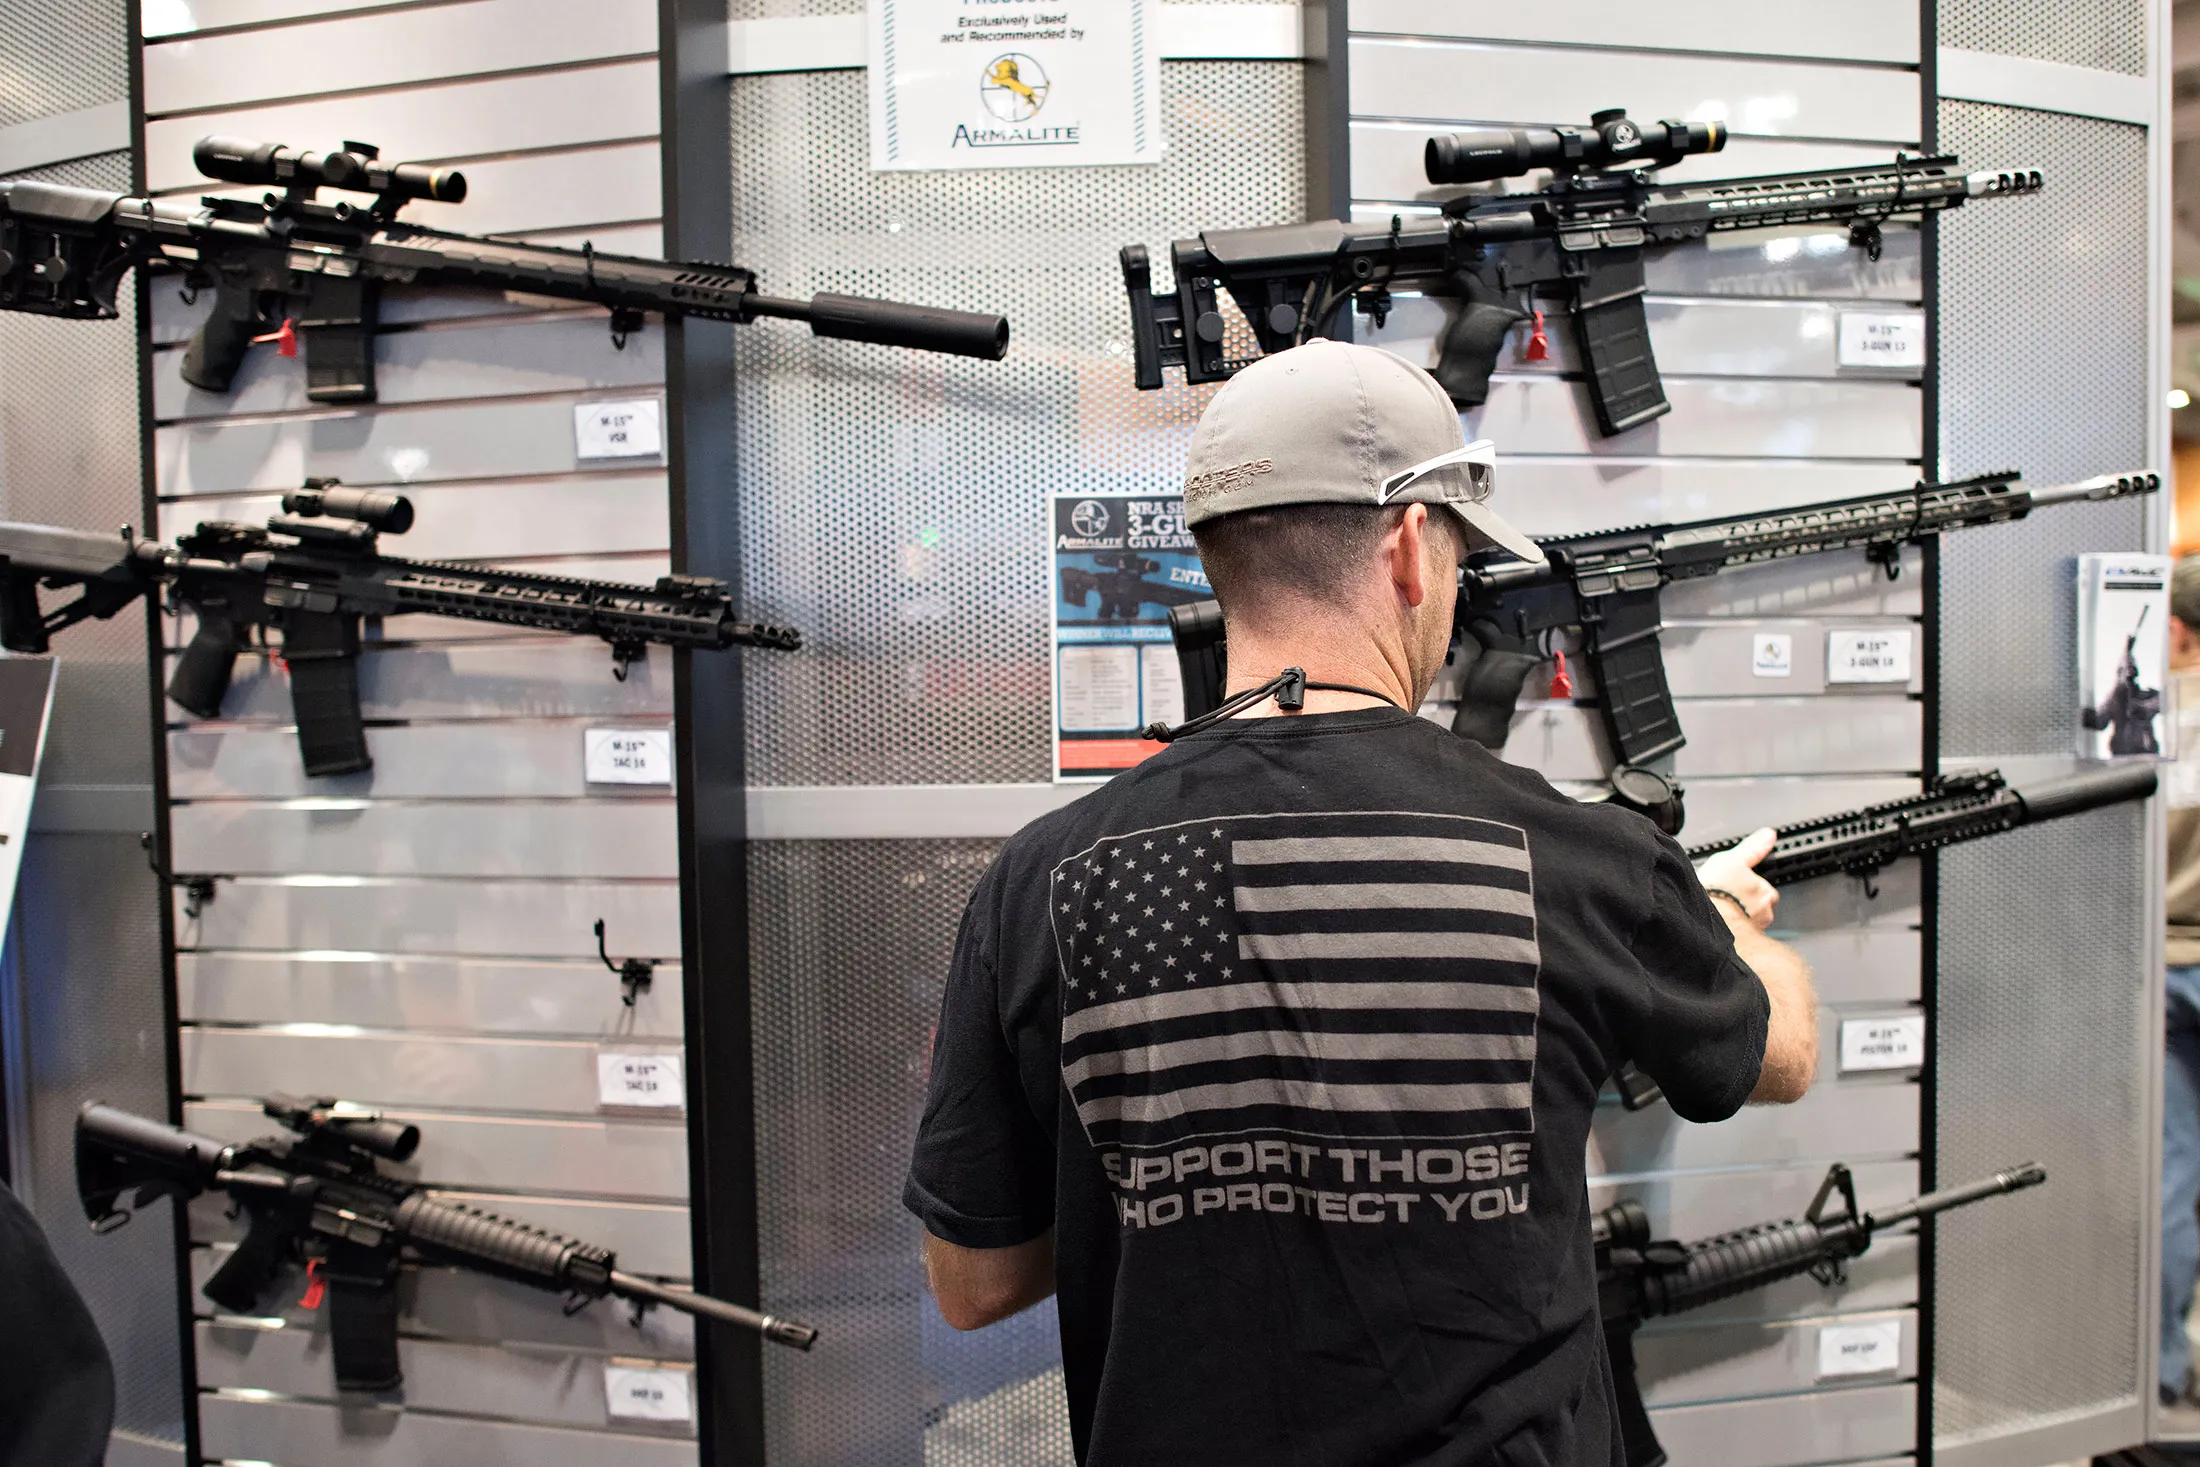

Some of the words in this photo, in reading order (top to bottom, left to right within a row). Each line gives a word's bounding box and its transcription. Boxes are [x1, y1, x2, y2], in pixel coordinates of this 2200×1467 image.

[958, 14, 1029, 28] Exclusively
[1034, 13, 1067, 25] Used
[940, 32, 964, 43] and
[970, 29, 1066, 42] Recommended
[1070, 28, 1085, 41] by
[952, 124, 1079, 148] ARMALITE
[1127, 501, 1163, 515] NRA
[1101, 1140, 1321, 1191] SUPPORT
[1328, 1142, 1531, 1183] THOSE
[1193, 1182, 1421, 1223] PROTECT
[1430, 1183, 1530, 1222] YOU
